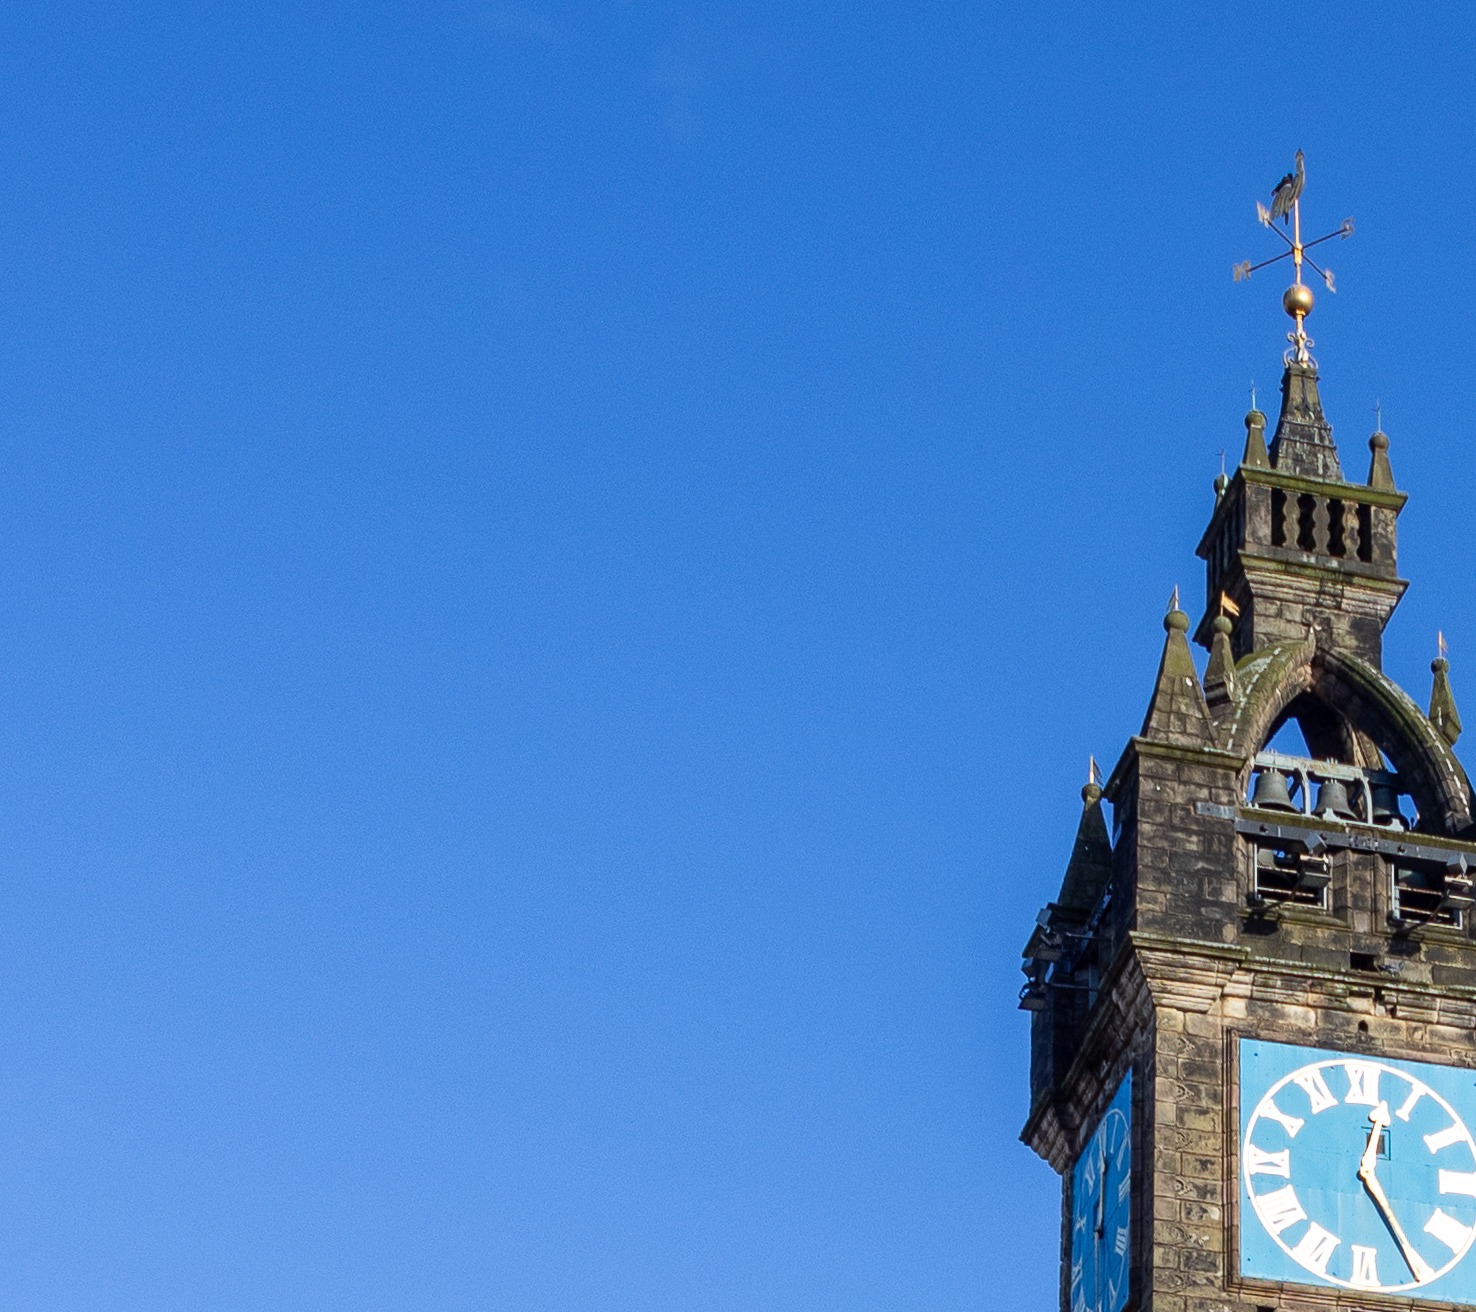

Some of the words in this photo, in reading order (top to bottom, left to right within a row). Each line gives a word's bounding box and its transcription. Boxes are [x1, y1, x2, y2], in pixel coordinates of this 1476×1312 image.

[1293, 1068, 1338, 1114] XI
[1345, 1064, 1381, 1105] XII
[1395, 1083, 1426, 1122] I
[1259, 1098, 1305, 1138] X
[1249, 1143, 1290, 1178] IX
[1255, 1184, 1307, 1235] VIII
[1292, 1221, 1341, 1273] VII
[1349, 1244, 1381, 1286] VI
